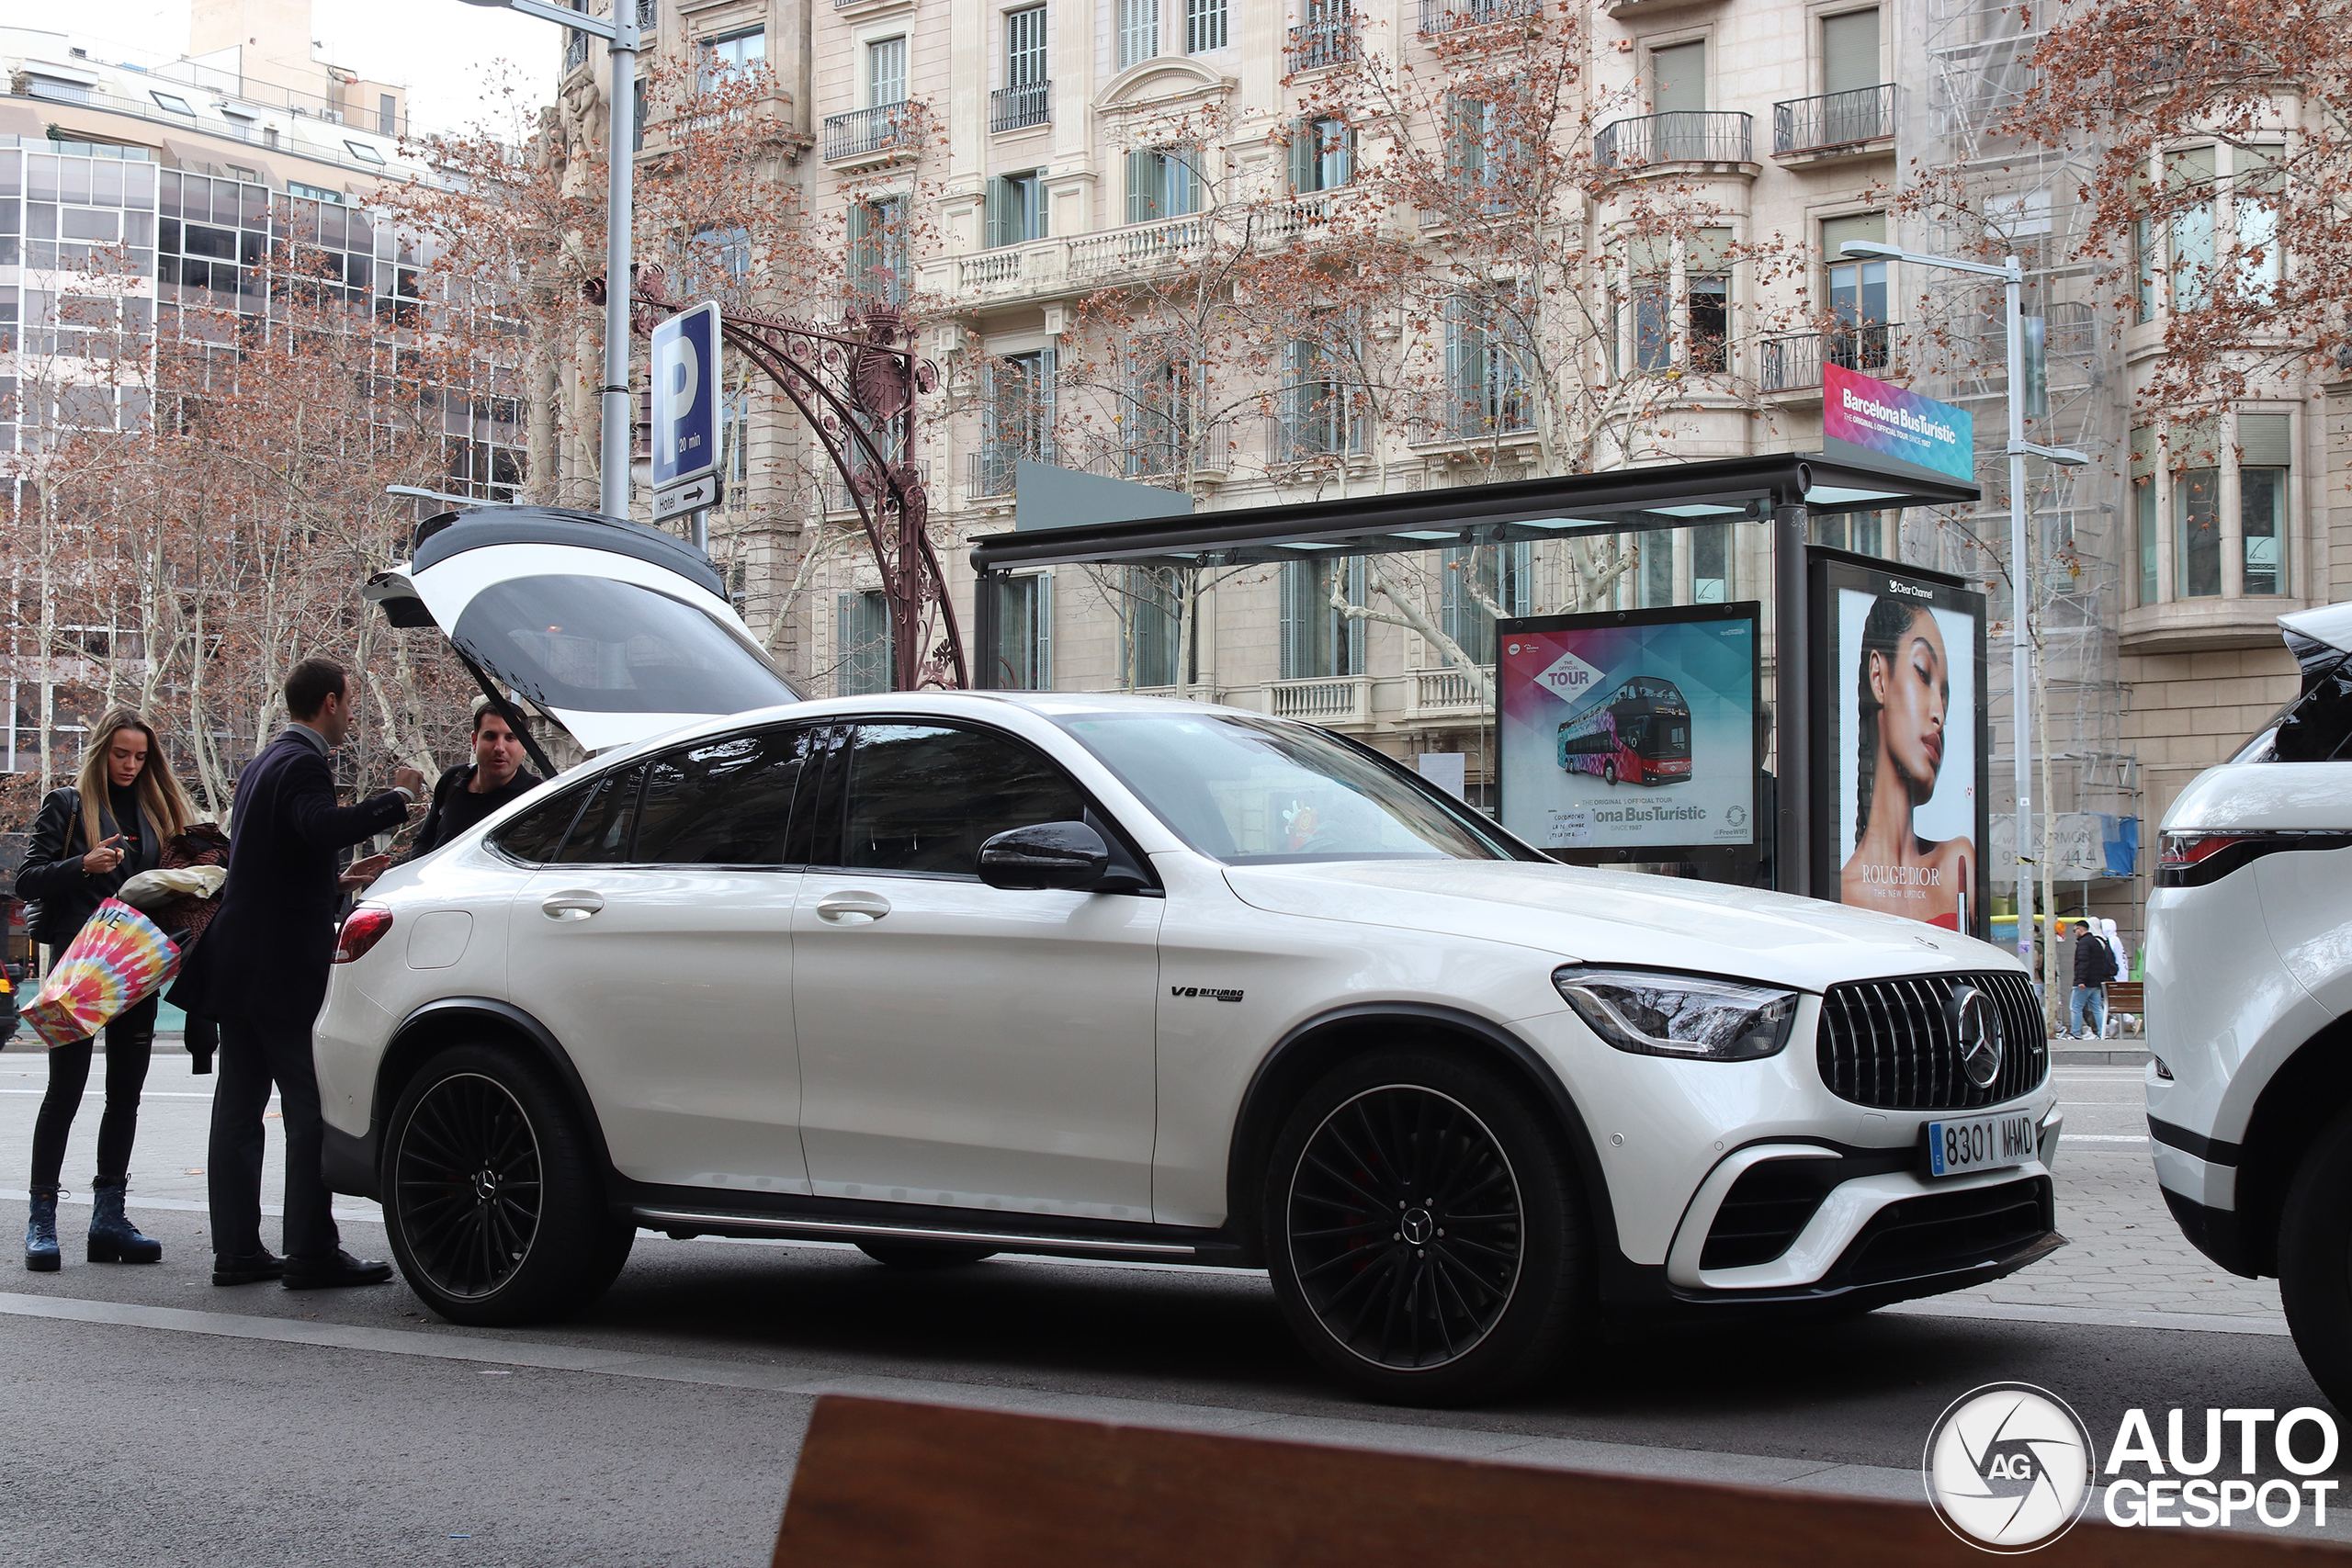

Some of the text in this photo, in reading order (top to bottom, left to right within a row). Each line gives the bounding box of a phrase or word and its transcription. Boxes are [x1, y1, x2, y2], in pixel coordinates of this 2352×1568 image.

[662, 336, 698, 465] P
[1843, 388, 1956, 445] Barcelona BusTurístic
[1844, 412, 1852, 423] THE
[1852, 415, 1873, 430] ORIGINAL
[1877, 423, 1896, 437] OFFICIAL
[1896, 430, 1909, 441] TOUR
[1908, 434, 1922, 446] SINCE
[1921, 439, 1932, 448] 1987
[679, 432, 701, 453] 20 min
[659, 493, 675, 512] Hotel
[1897, 583, 1933, 599] Clear Channel
[1548, 671, 1589, 686] TOUR
[1625, 807, 1707, 822] BusTurístic
[1862, 864, 1940, 886] ROUGE DIOR
[1874, 888, 1927, 899] THE NEW LIPSTICK
[1171, 986, 1244, 997] V8 BITURBO
[1945, 1117, 2033, 1167] 8301 MMD
[1935, 1155, 1941, 1166] E
